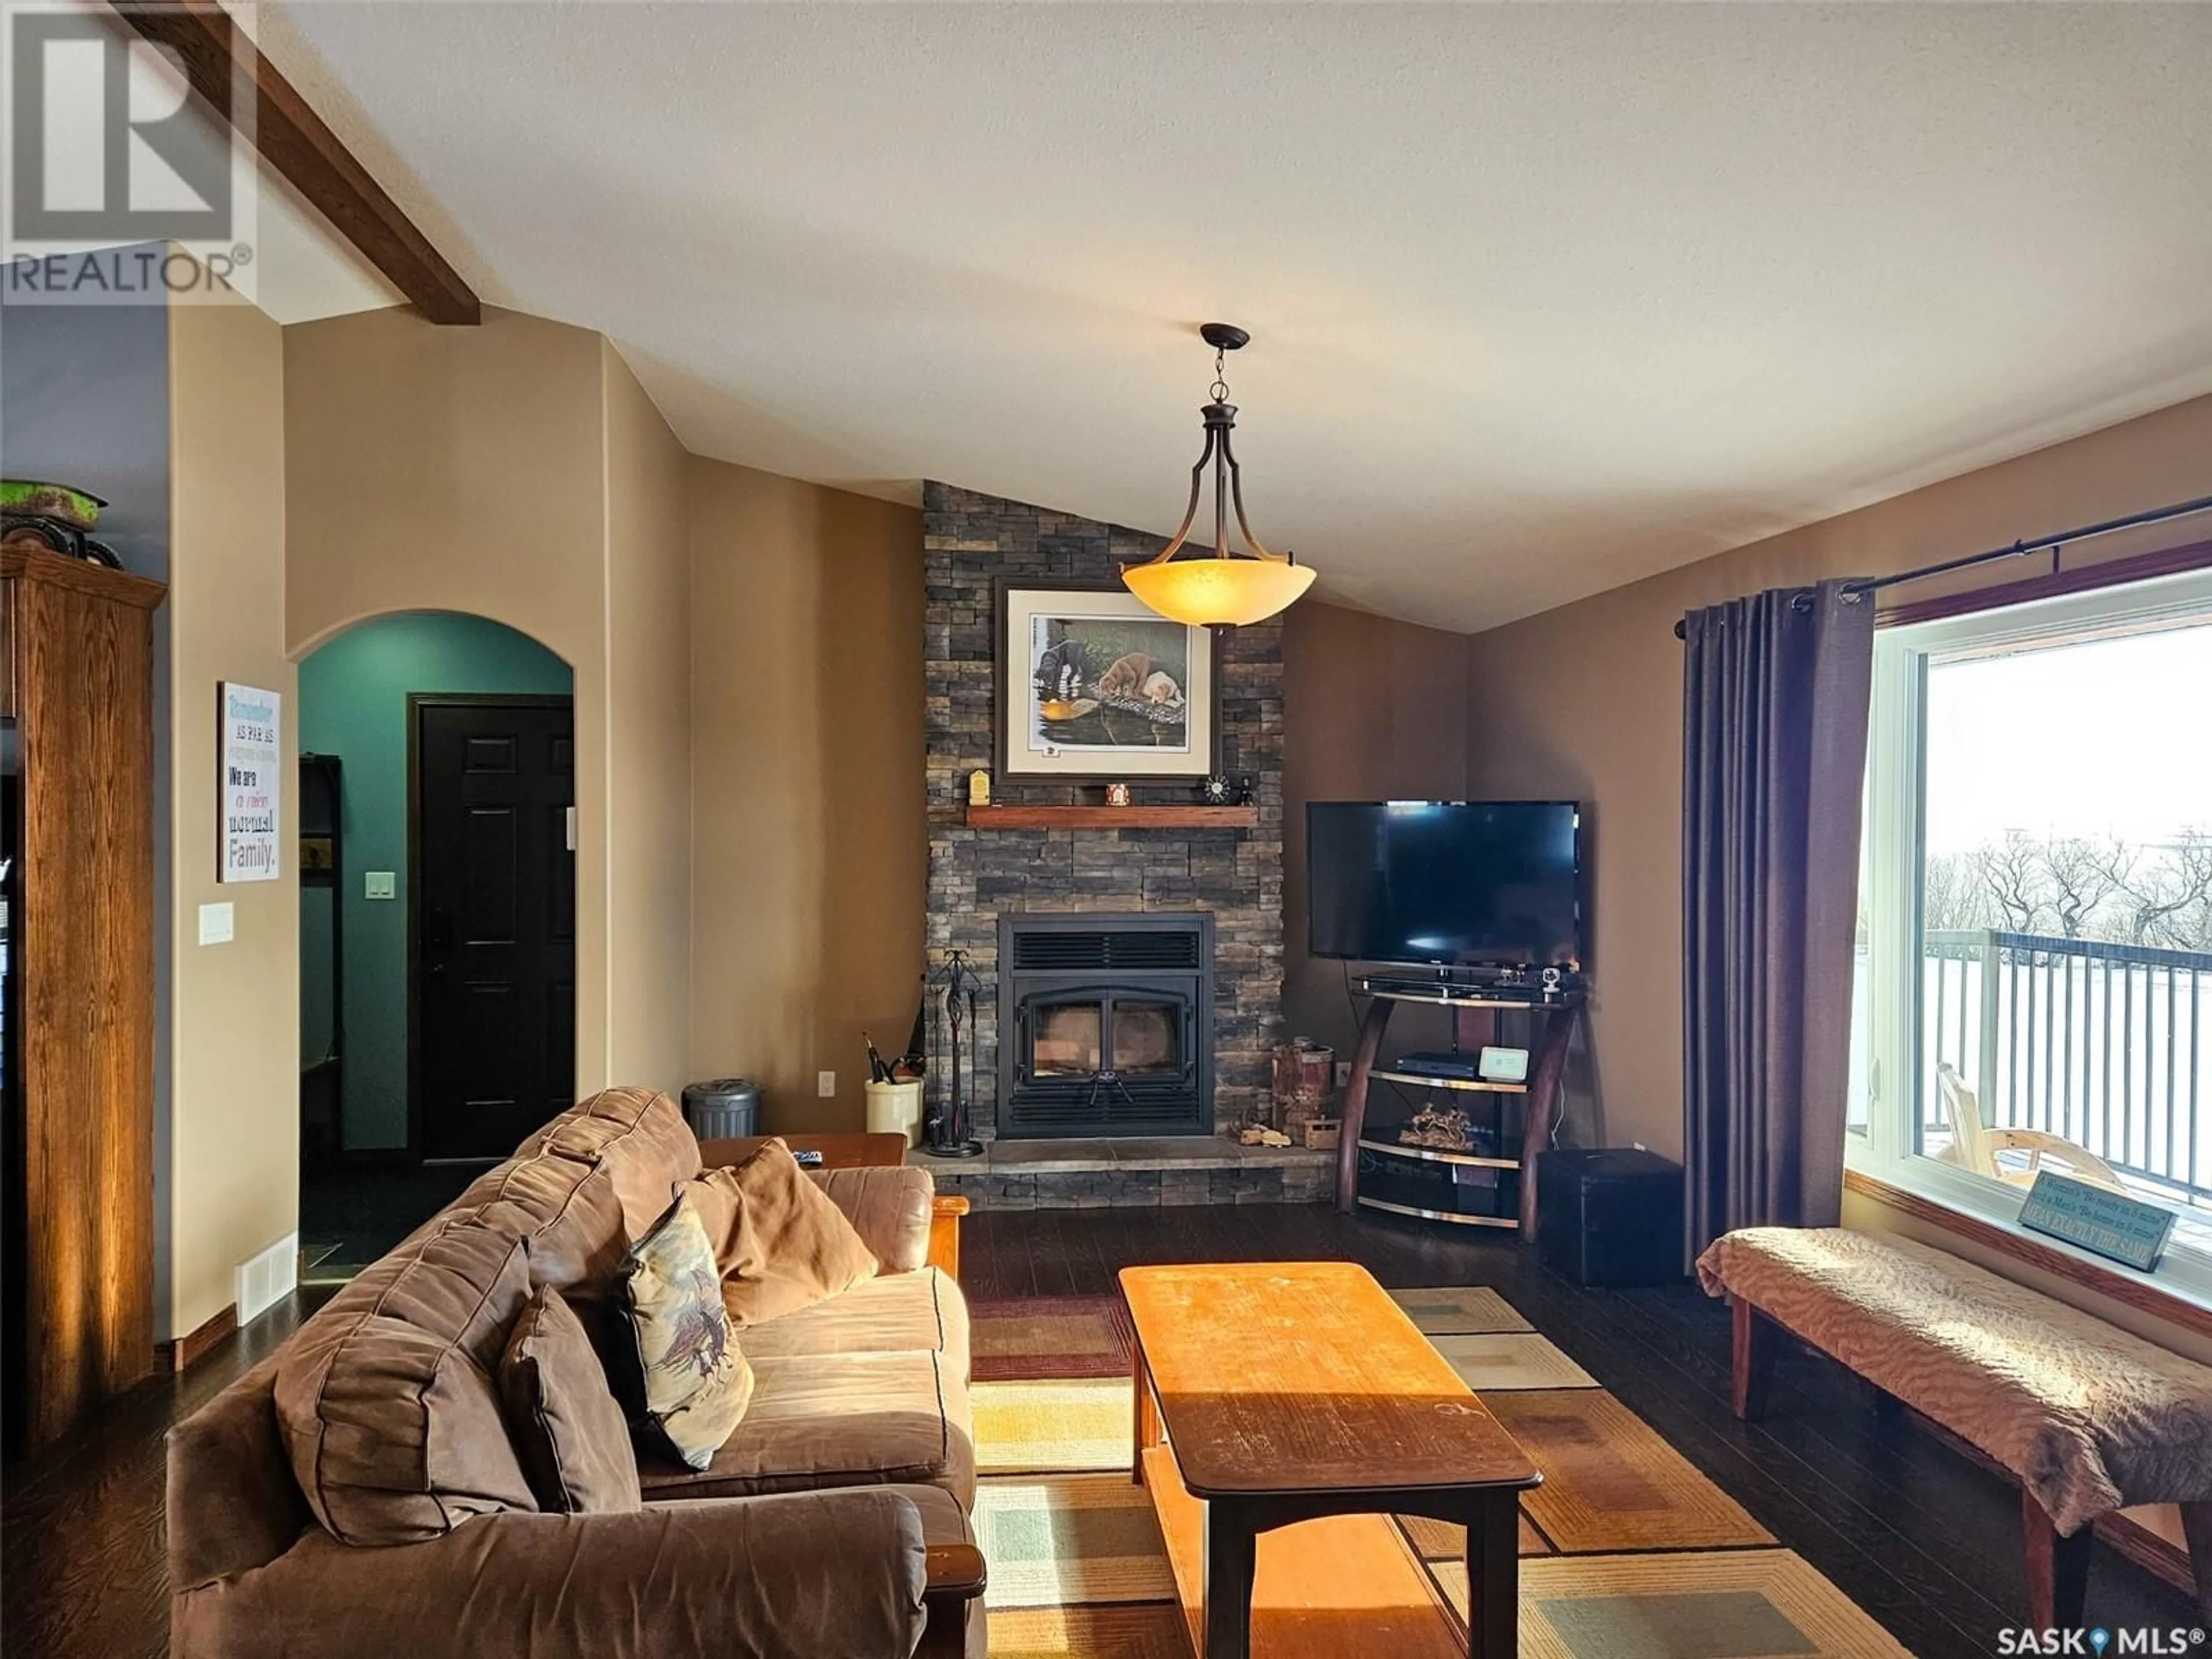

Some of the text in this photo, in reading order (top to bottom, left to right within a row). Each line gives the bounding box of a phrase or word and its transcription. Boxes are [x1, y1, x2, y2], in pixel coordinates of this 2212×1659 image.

[229, 767, 257, 787] We are
[229, 809, 274, 833] normal
[229, 838, 275, 873] Family.
[2022, 1202, 2155, 1263] MEAN EXACTLY THE SAME
